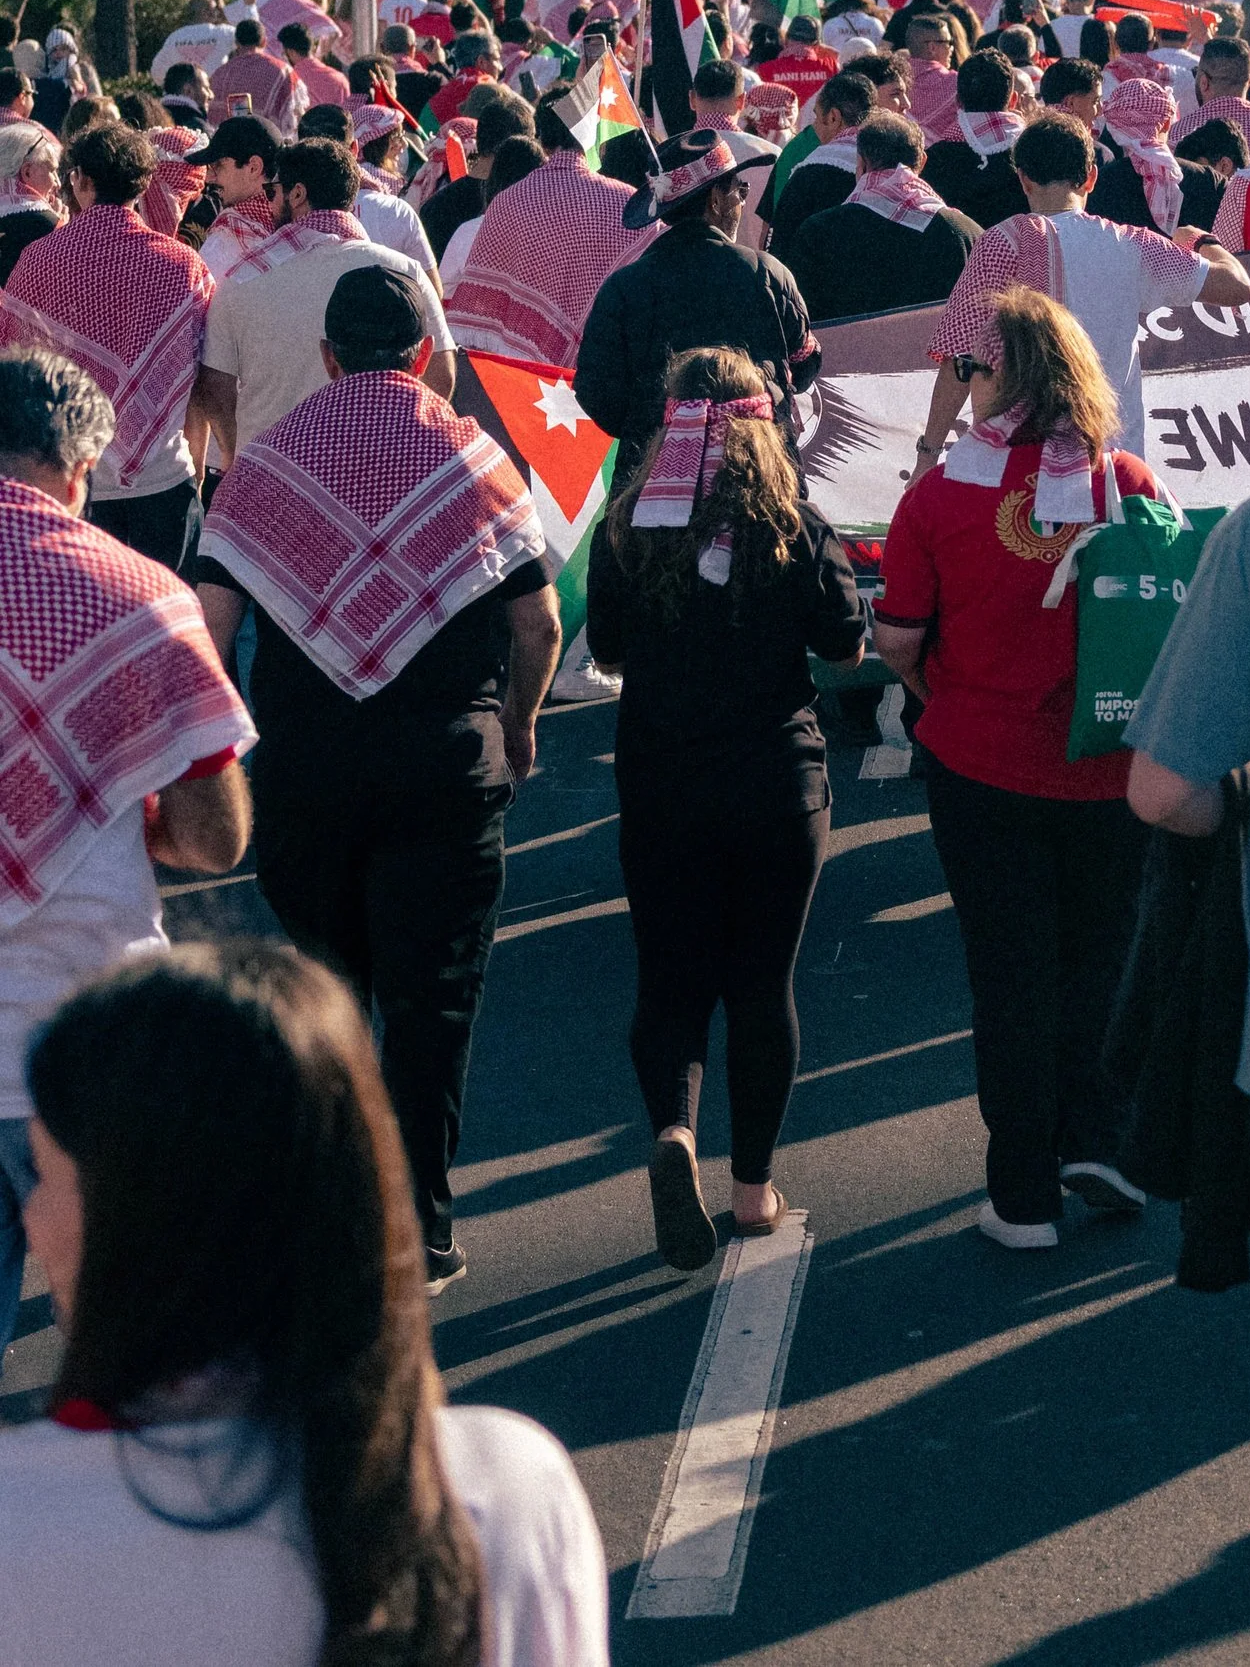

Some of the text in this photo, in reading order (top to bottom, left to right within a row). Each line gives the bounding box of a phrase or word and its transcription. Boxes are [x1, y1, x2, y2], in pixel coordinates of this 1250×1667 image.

[773, 71, 827, 82] BANI HANI
[1095, 711, 1115, 722] TO
